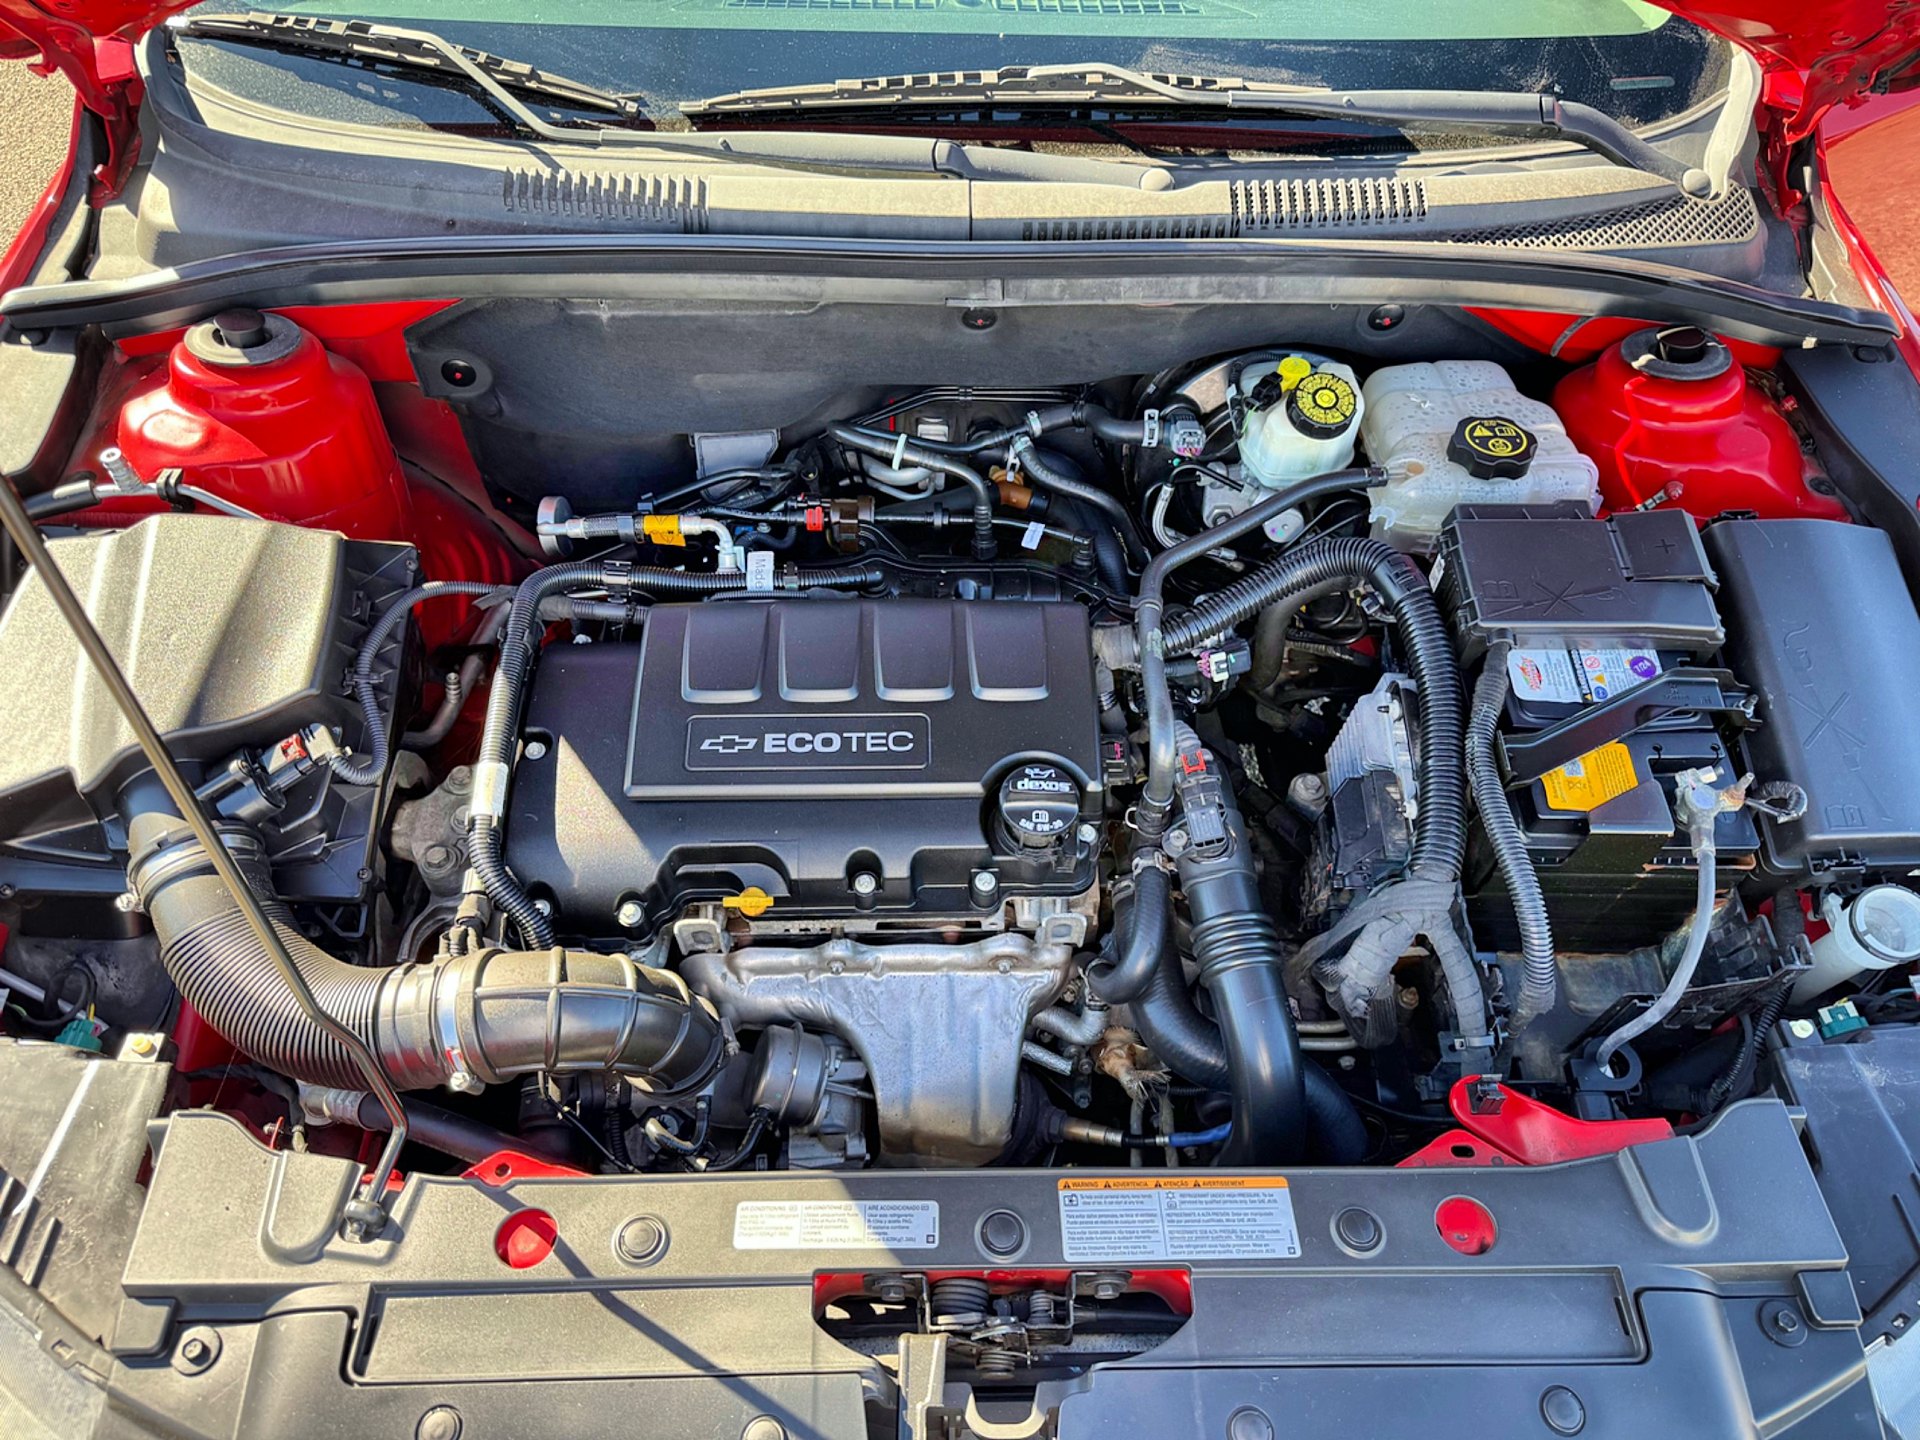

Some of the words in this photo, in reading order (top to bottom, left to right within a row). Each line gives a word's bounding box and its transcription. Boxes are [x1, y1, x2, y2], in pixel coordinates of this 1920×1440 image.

[763, 730, 914, 753] ECOTEC
[1017, 777, 1072, 792] dexos
[1202, 1179, 1246, 1187] AVERTISSEMENT
